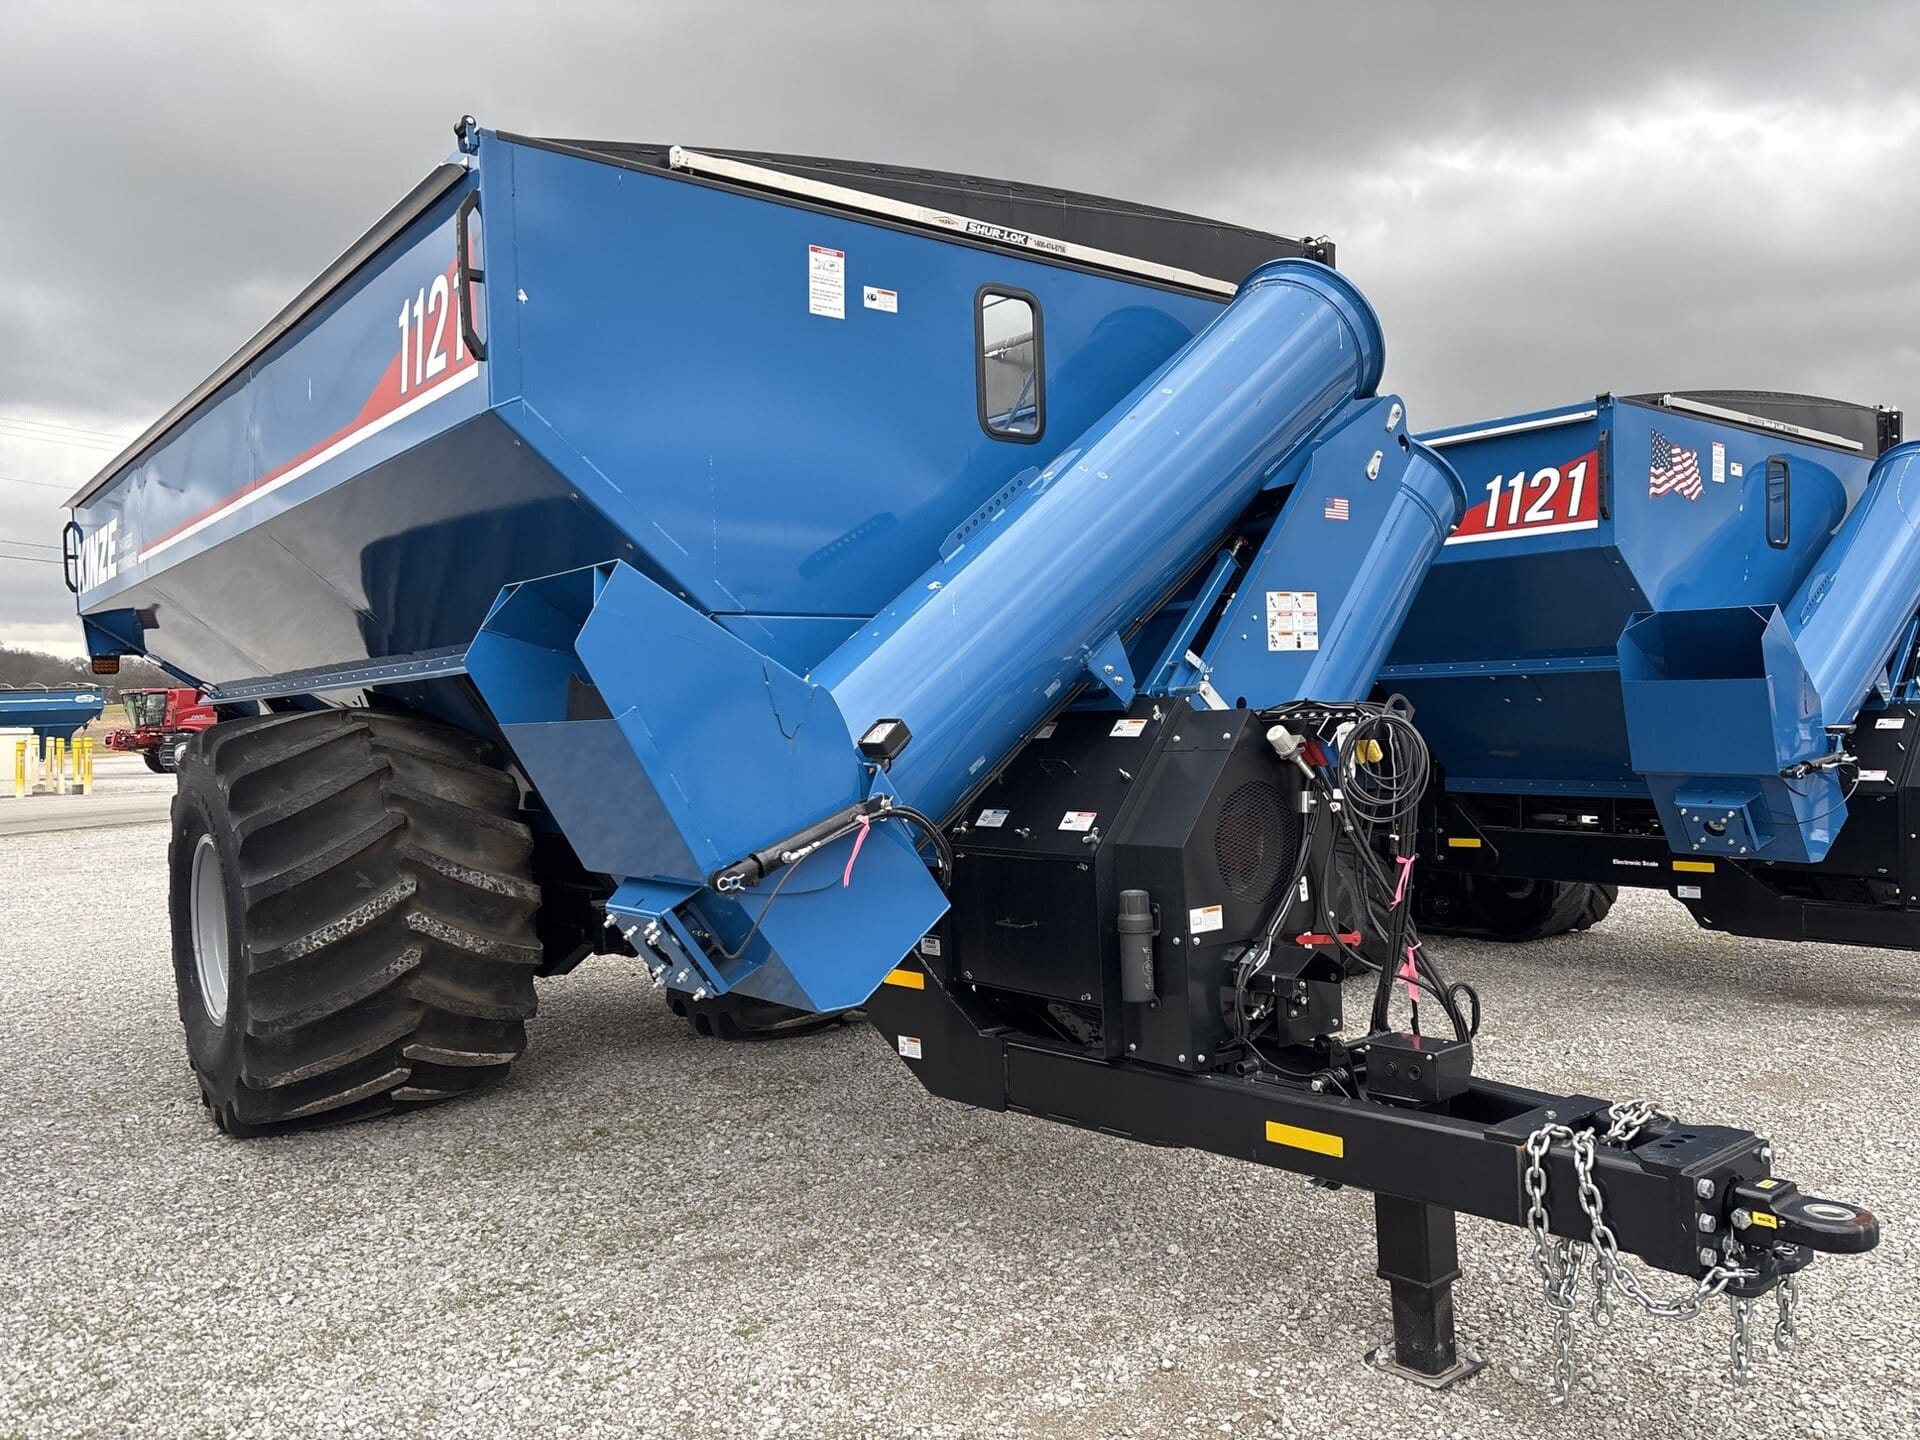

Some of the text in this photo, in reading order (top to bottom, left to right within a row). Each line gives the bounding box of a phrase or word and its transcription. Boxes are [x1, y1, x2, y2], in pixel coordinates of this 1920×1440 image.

[967, 222, 1028, 245] SHUR-LOK
[398, 271, 464, 394] 1121
[1485, 461, 1588, 528] 1121
[78, 517, 118, 597] KINZE
[1612, 858, 1642, 866] Electronic
